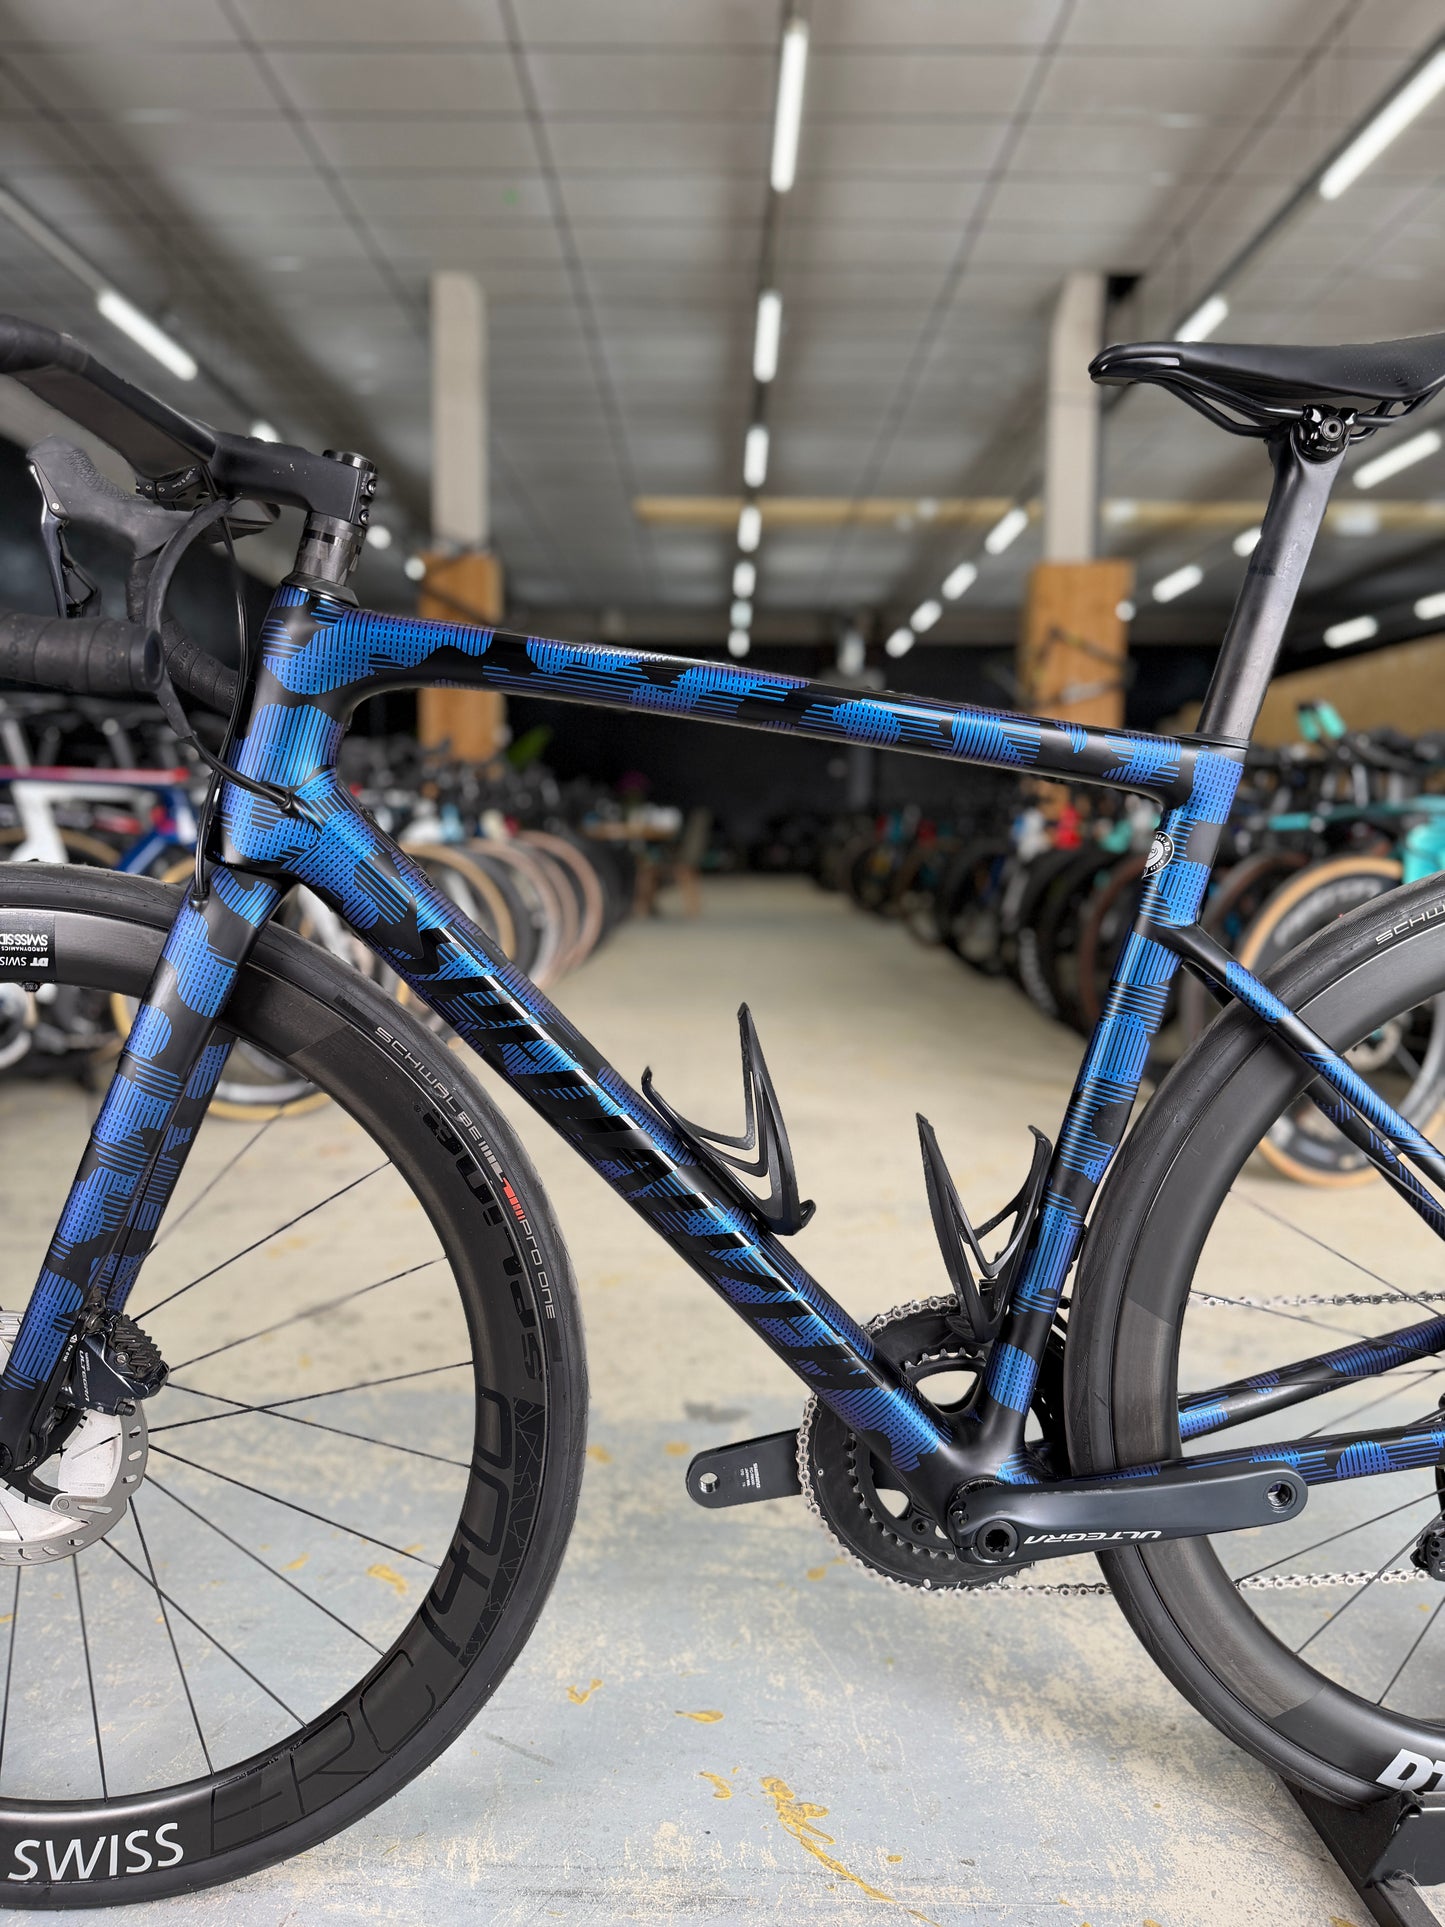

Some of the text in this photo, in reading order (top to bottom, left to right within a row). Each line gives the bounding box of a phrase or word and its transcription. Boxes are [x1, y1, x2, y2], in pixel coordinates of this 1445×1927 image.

[30, 957, 49, 967] DT
[374, 1025, 482, 1141] SCHWALBE
[421, 1388, 518, 1658] 1400
[1023, 1530, 1162, 1545] ULTEGRA
[210, 1648, 437, 1856] ERC
[8, 1821, 184, 1882] SWISS
